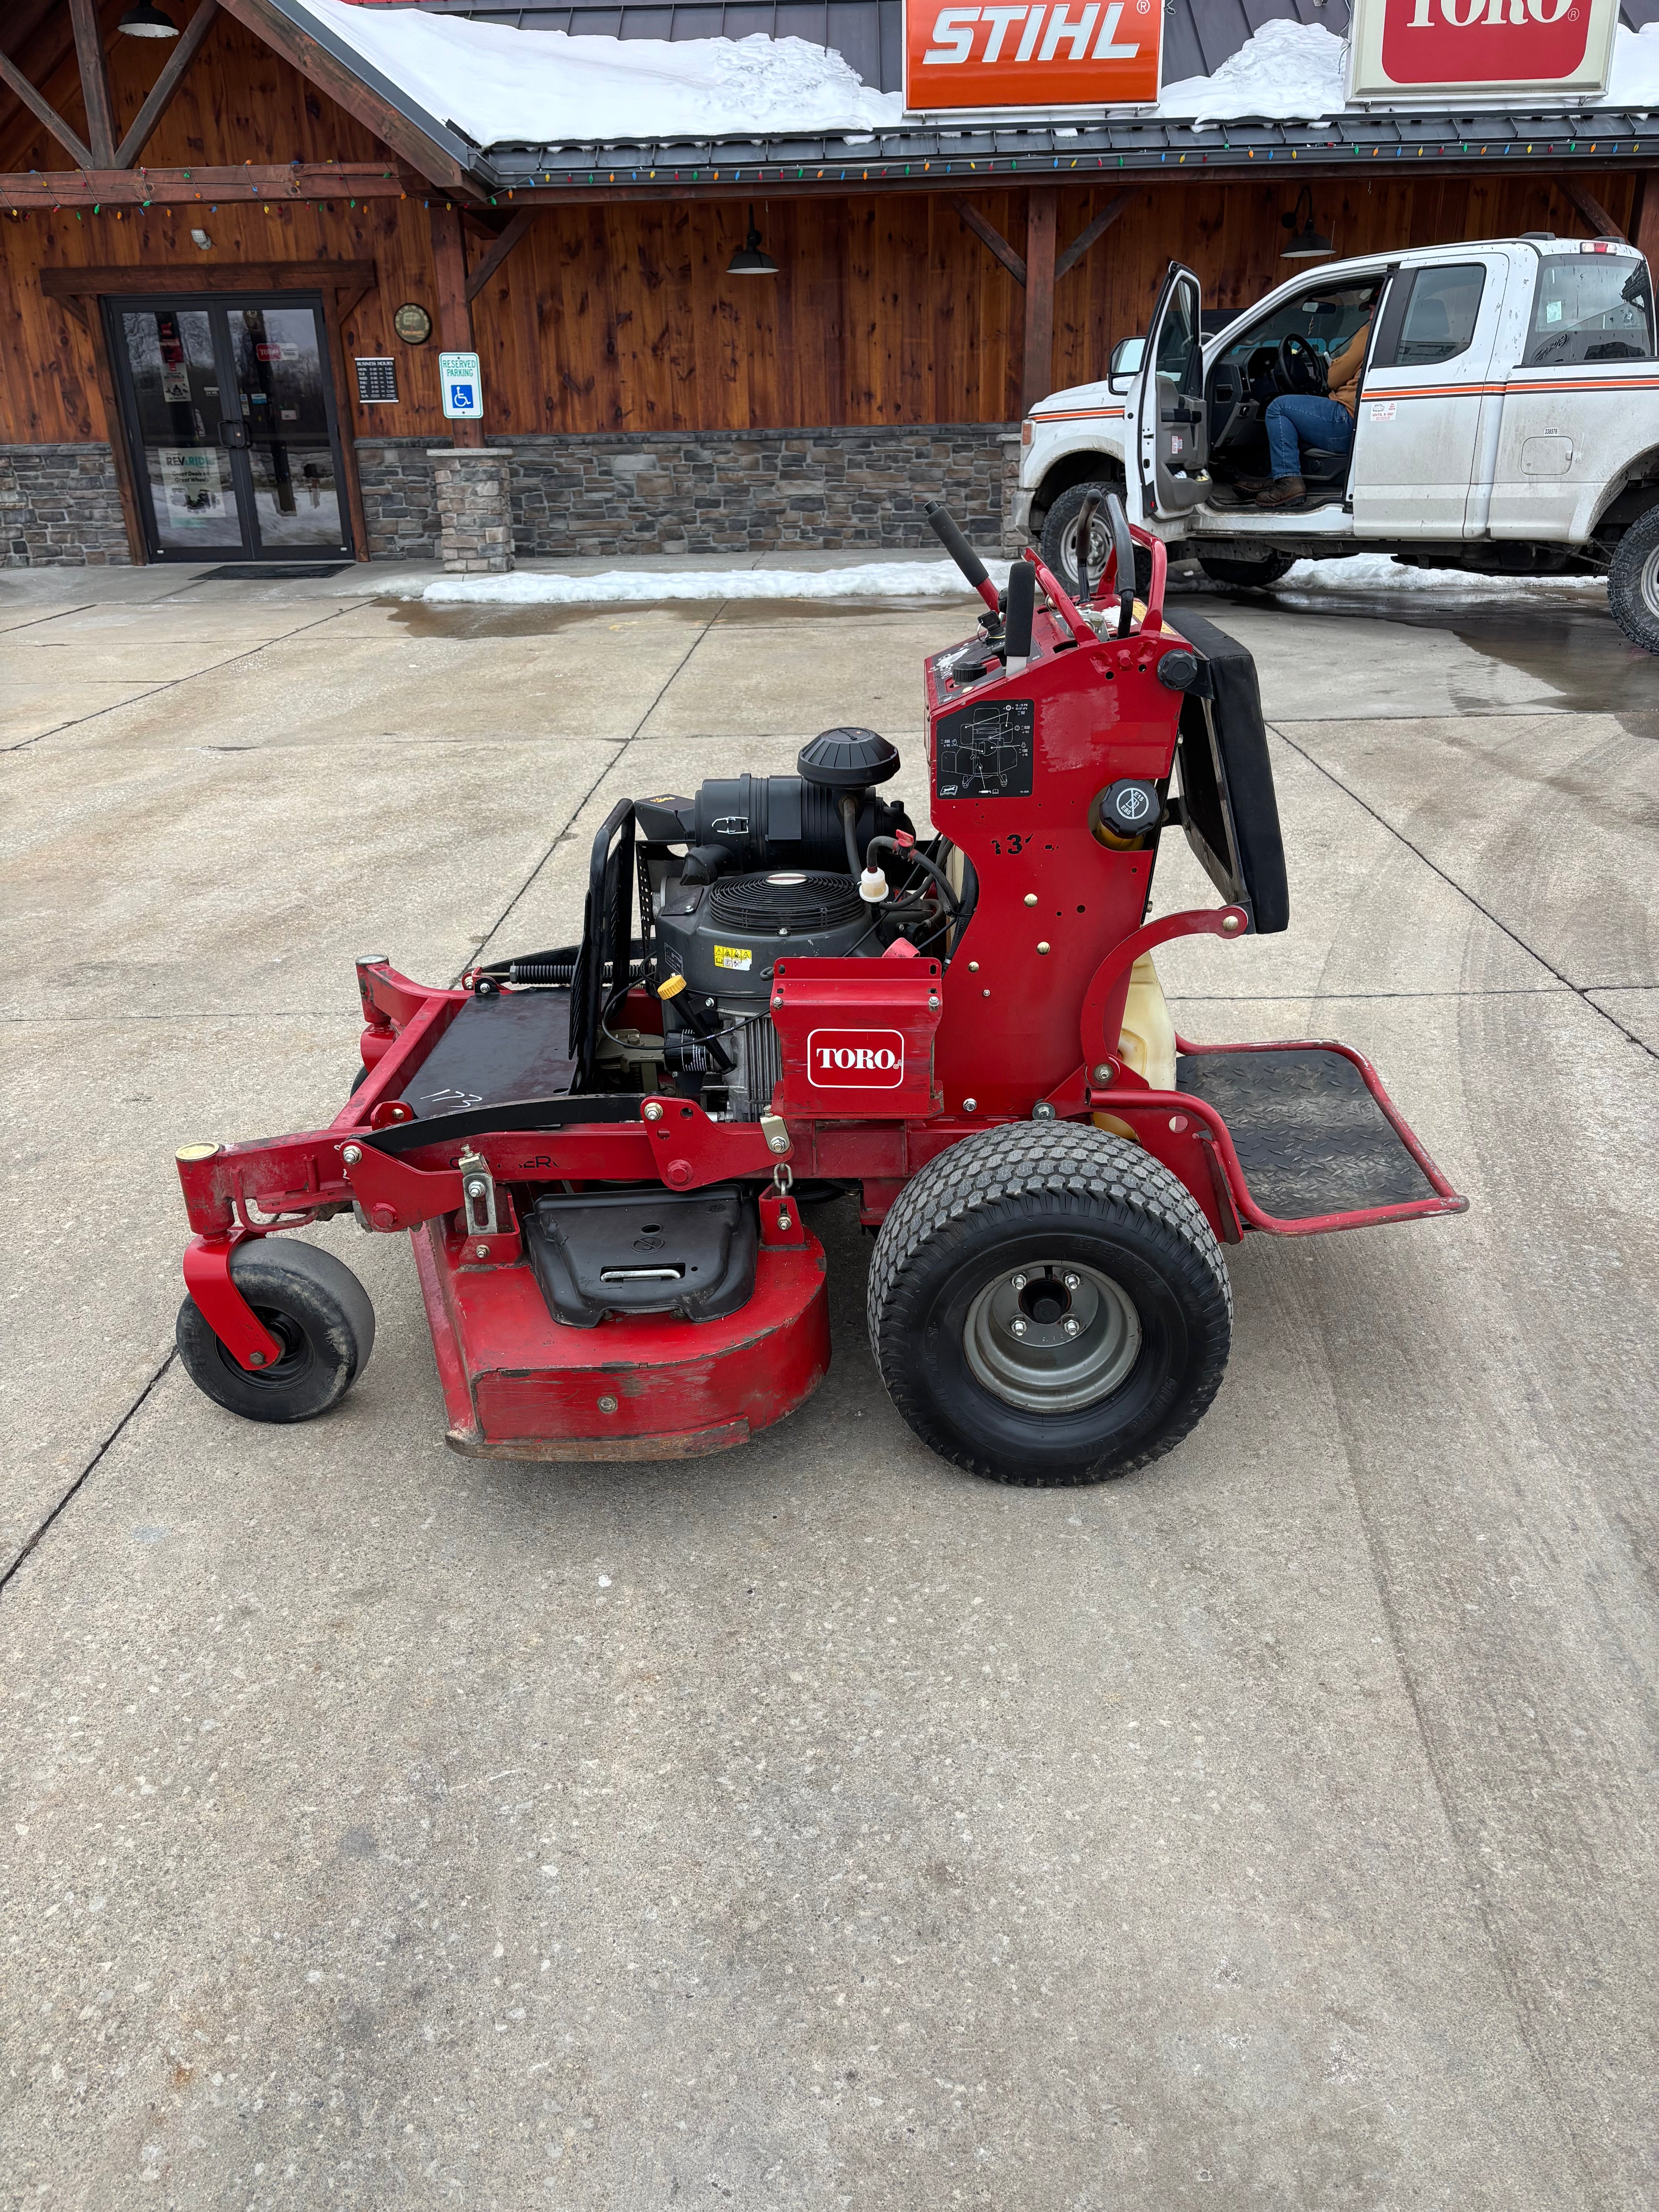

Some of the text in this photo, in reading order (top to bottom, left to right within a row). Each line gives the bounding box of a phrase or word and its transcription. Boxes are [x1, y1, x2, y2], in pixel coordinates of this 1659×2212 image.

[922, 3, 1140, 64] STIHL
[1134, 792, 1144, 802] E15
[1121, 805, 1131, 815] E85
[816, 1048, 895, 1069] TORO
